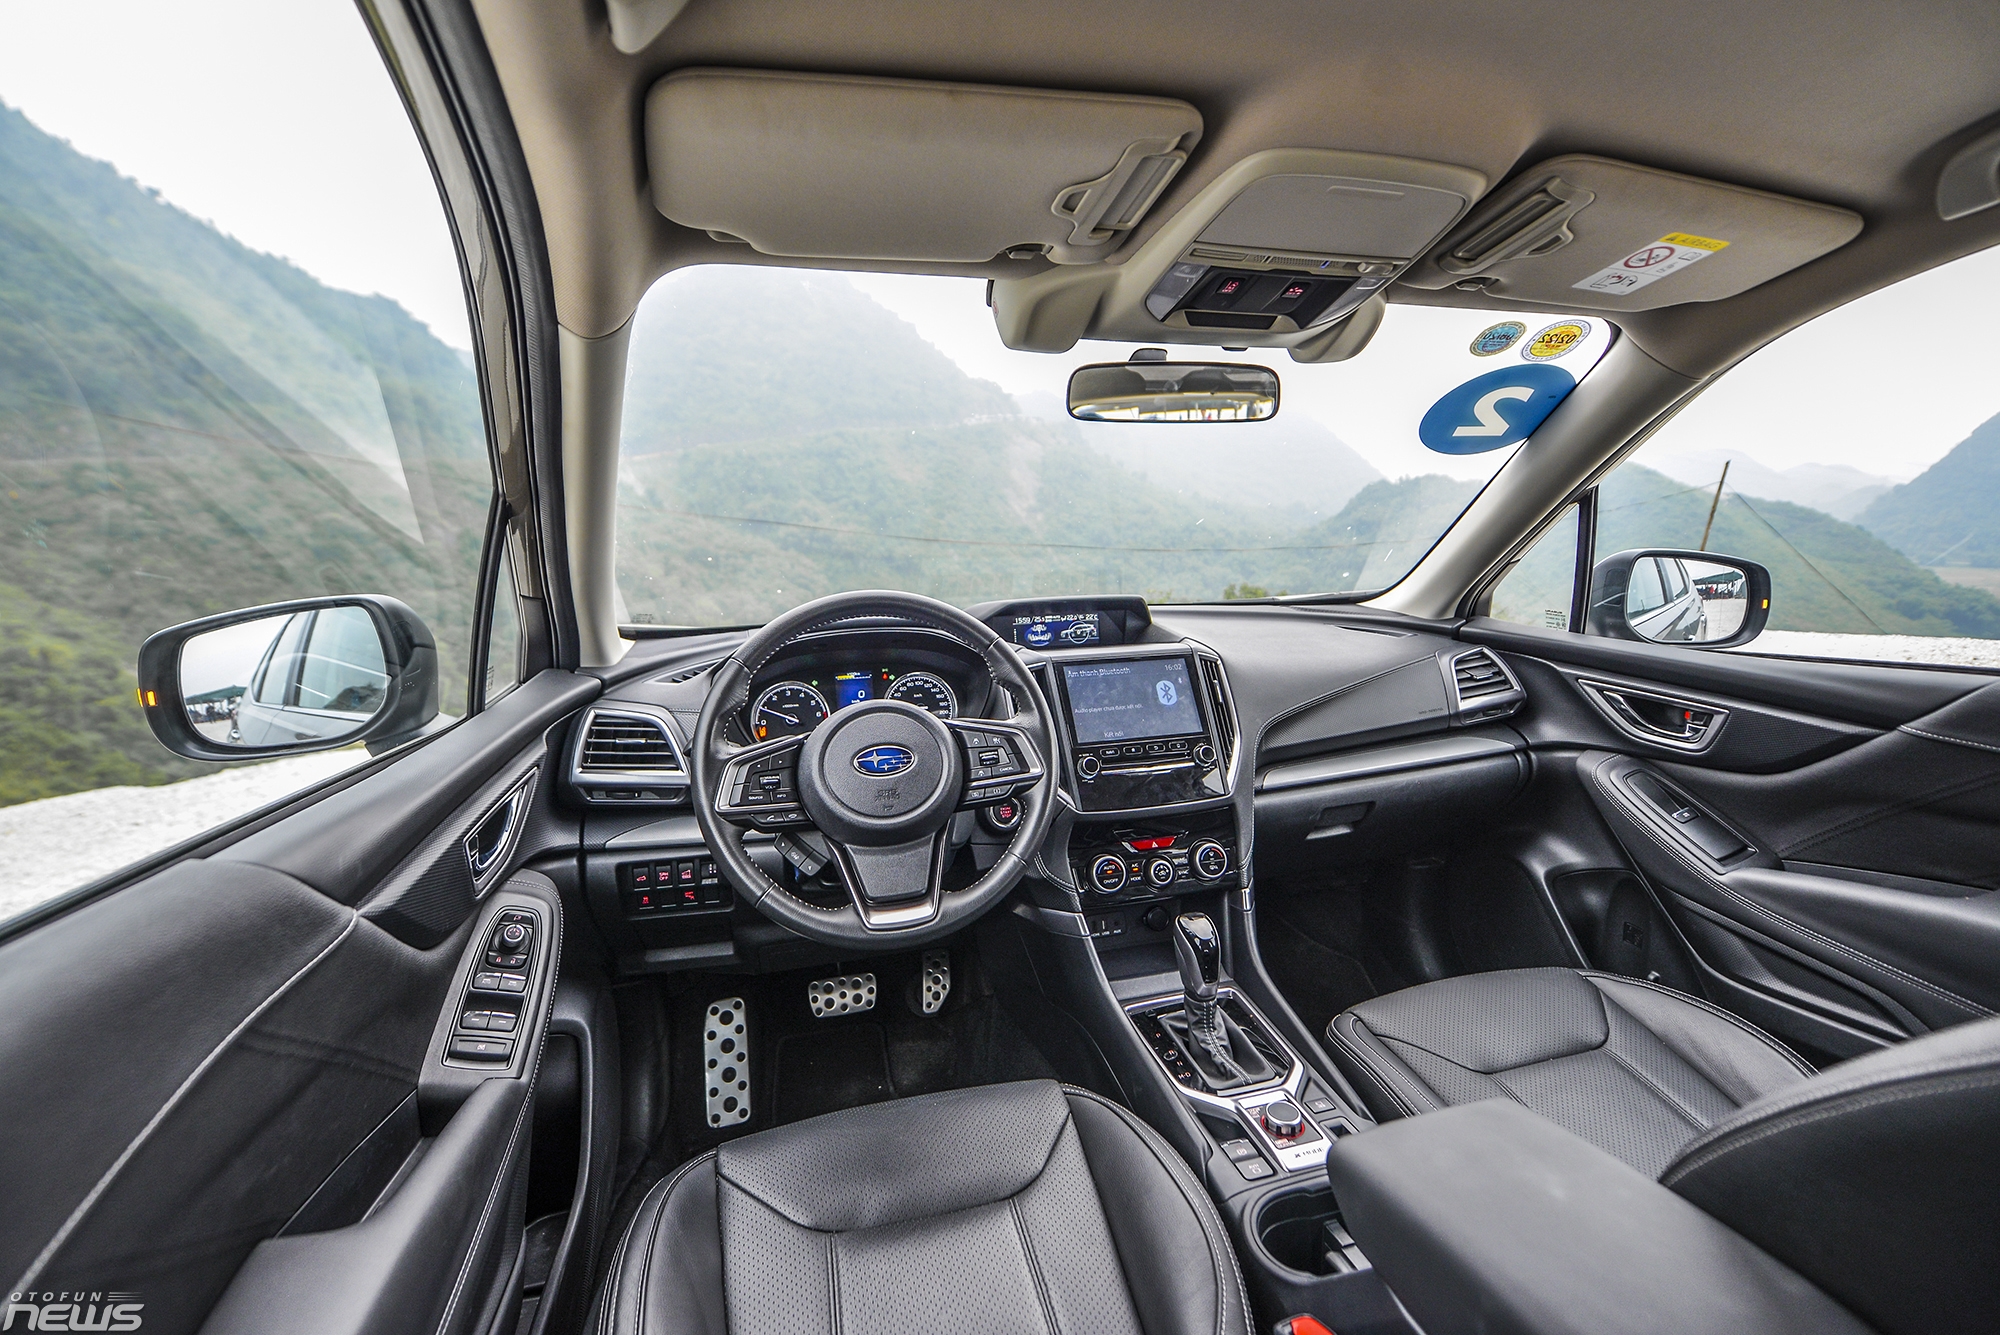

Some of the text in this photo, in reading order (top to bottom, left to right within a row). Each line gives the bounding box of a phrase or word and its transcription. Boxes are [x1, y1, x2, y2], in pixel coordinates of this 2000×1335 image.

[1099, 667, 1131, 676] Bluetooth
[1164, 663, 1182, 671] 16:02
[857, 689, 866, 699] 0
